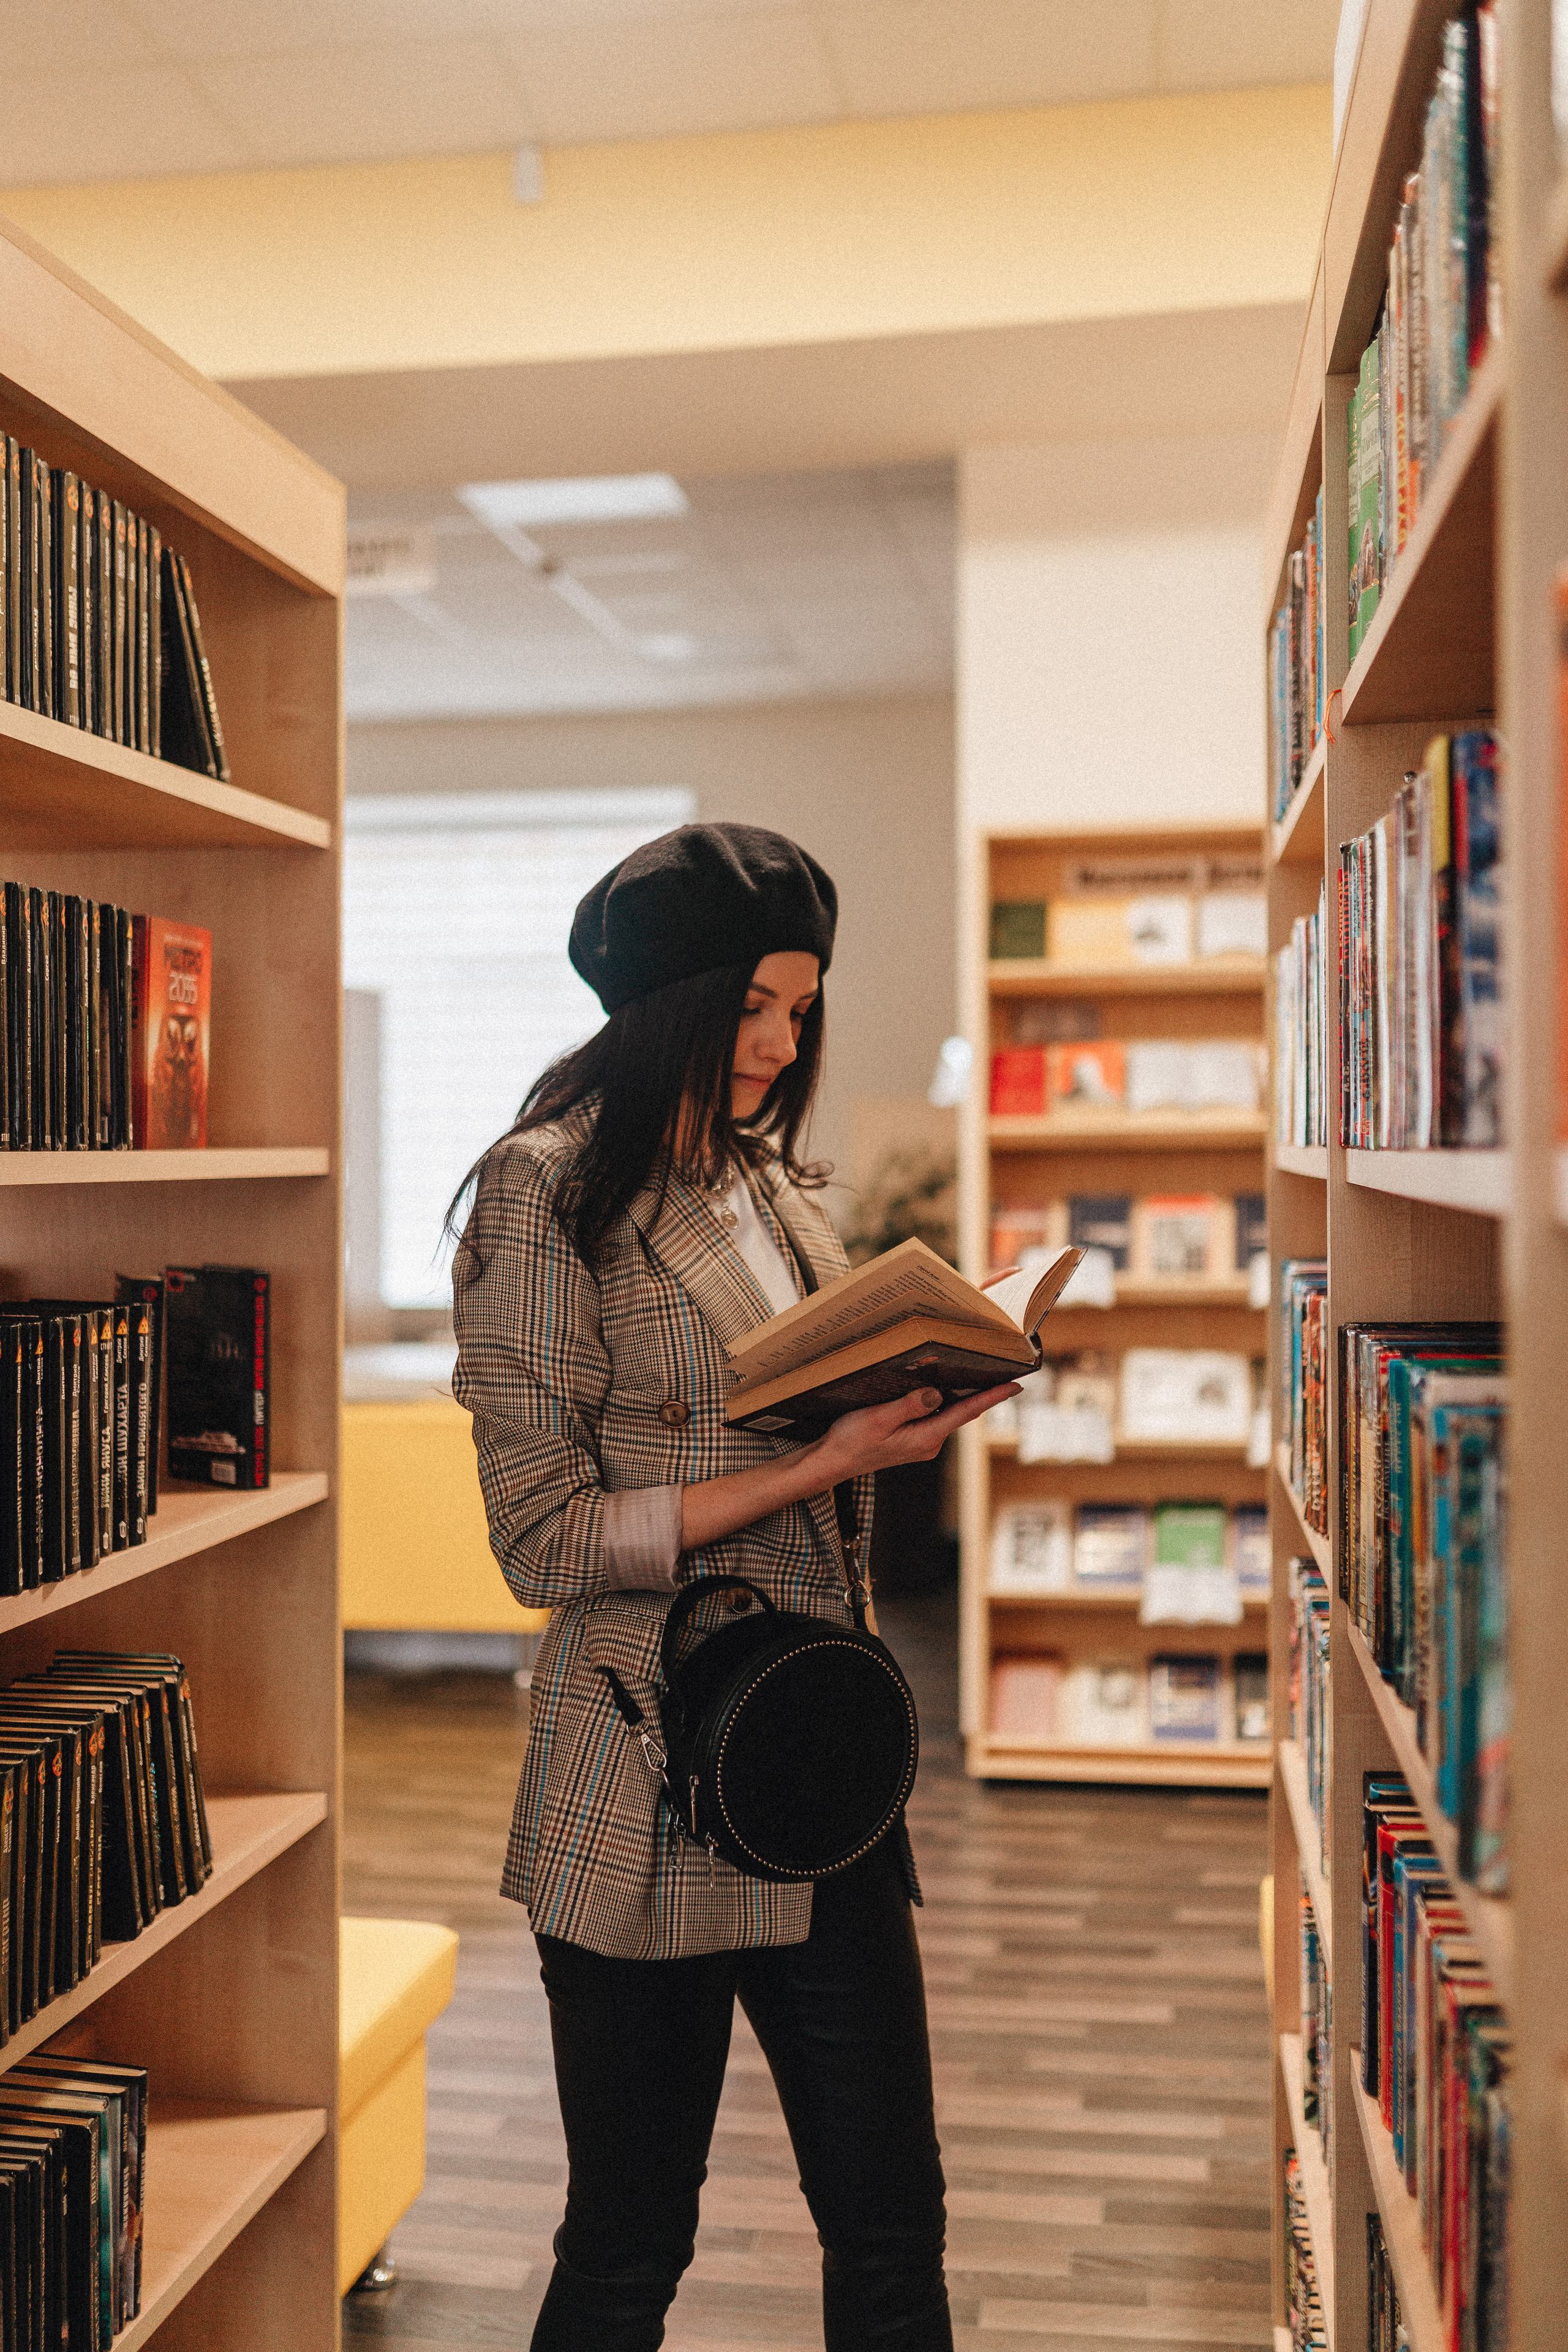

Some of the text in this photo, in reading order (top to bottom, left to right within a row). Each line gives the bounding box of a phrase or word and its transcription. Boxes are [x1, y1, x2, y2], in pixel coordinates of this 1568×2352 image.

[116, 1383, 128, 1452] ШУХАРТА
[135, 1382, 147, 1498] ЗАКОН ПРОКЛЯТОГО
[253, 1390, 265, 1425] ПИТЕР
[100, 1425, 111, 1508] ЛИКИ ЯНУСА
